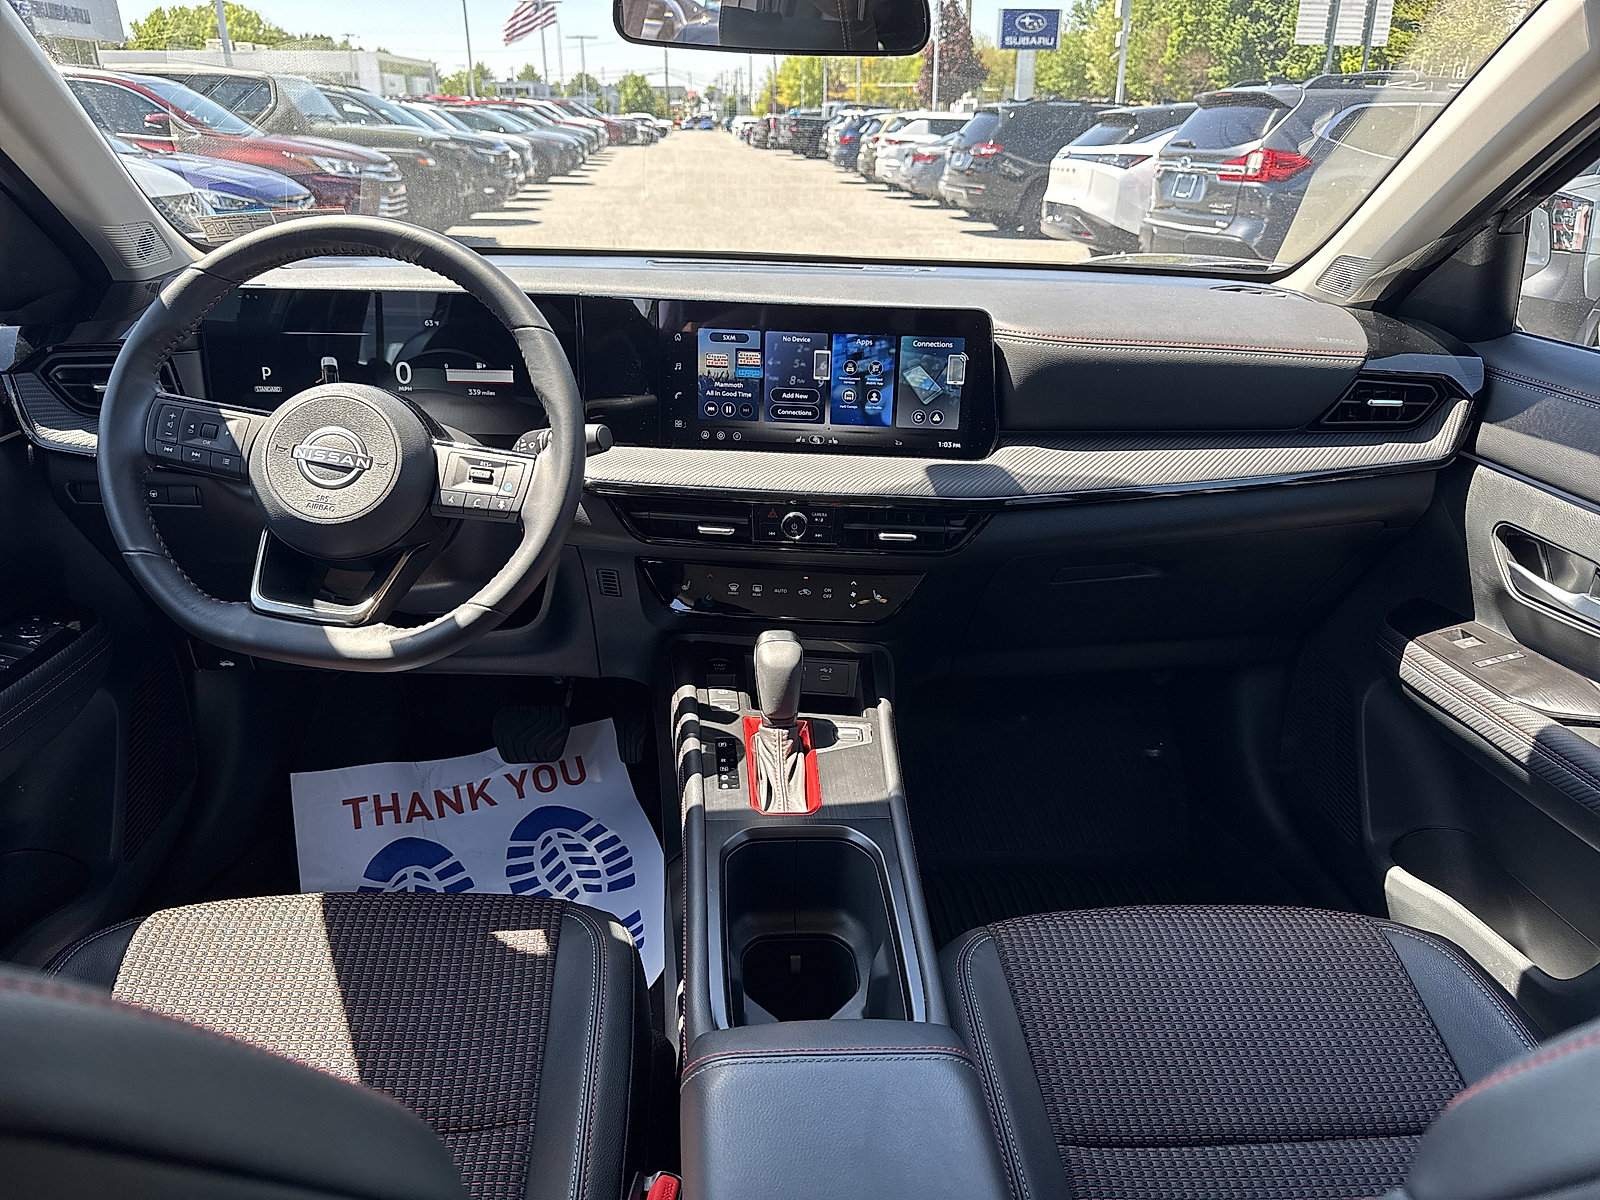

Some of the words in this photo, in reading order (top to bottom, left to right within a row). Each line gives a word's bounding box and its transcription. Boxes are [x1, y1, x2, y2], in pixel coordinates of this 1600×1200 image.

[1004, 36, 1055, 46] SUBARU
[424, 319, 434, 327] 63
[792, 335, 811, 343] Device
[855, 338, 873, 346] Apps
[912, 340, 954, 348] Connections
[793, 358, 800, 369] 5
[820, 360, 827, 370] 6
[261, 366, 272, 381] P
[395, 361, 412, 385] 0
[789, 375, 797, 386] 8
[467, 388, 482, 396] 339
[721, 390, 738, 398] Good
[777, 409, 812, 417] Connections
[293, 447, 371, 470] NISSAN
[305, 502, 336, 513] AIRBAG
[341, 777, 499, 831] THANK
[503, 754, 588, 800] YOU
